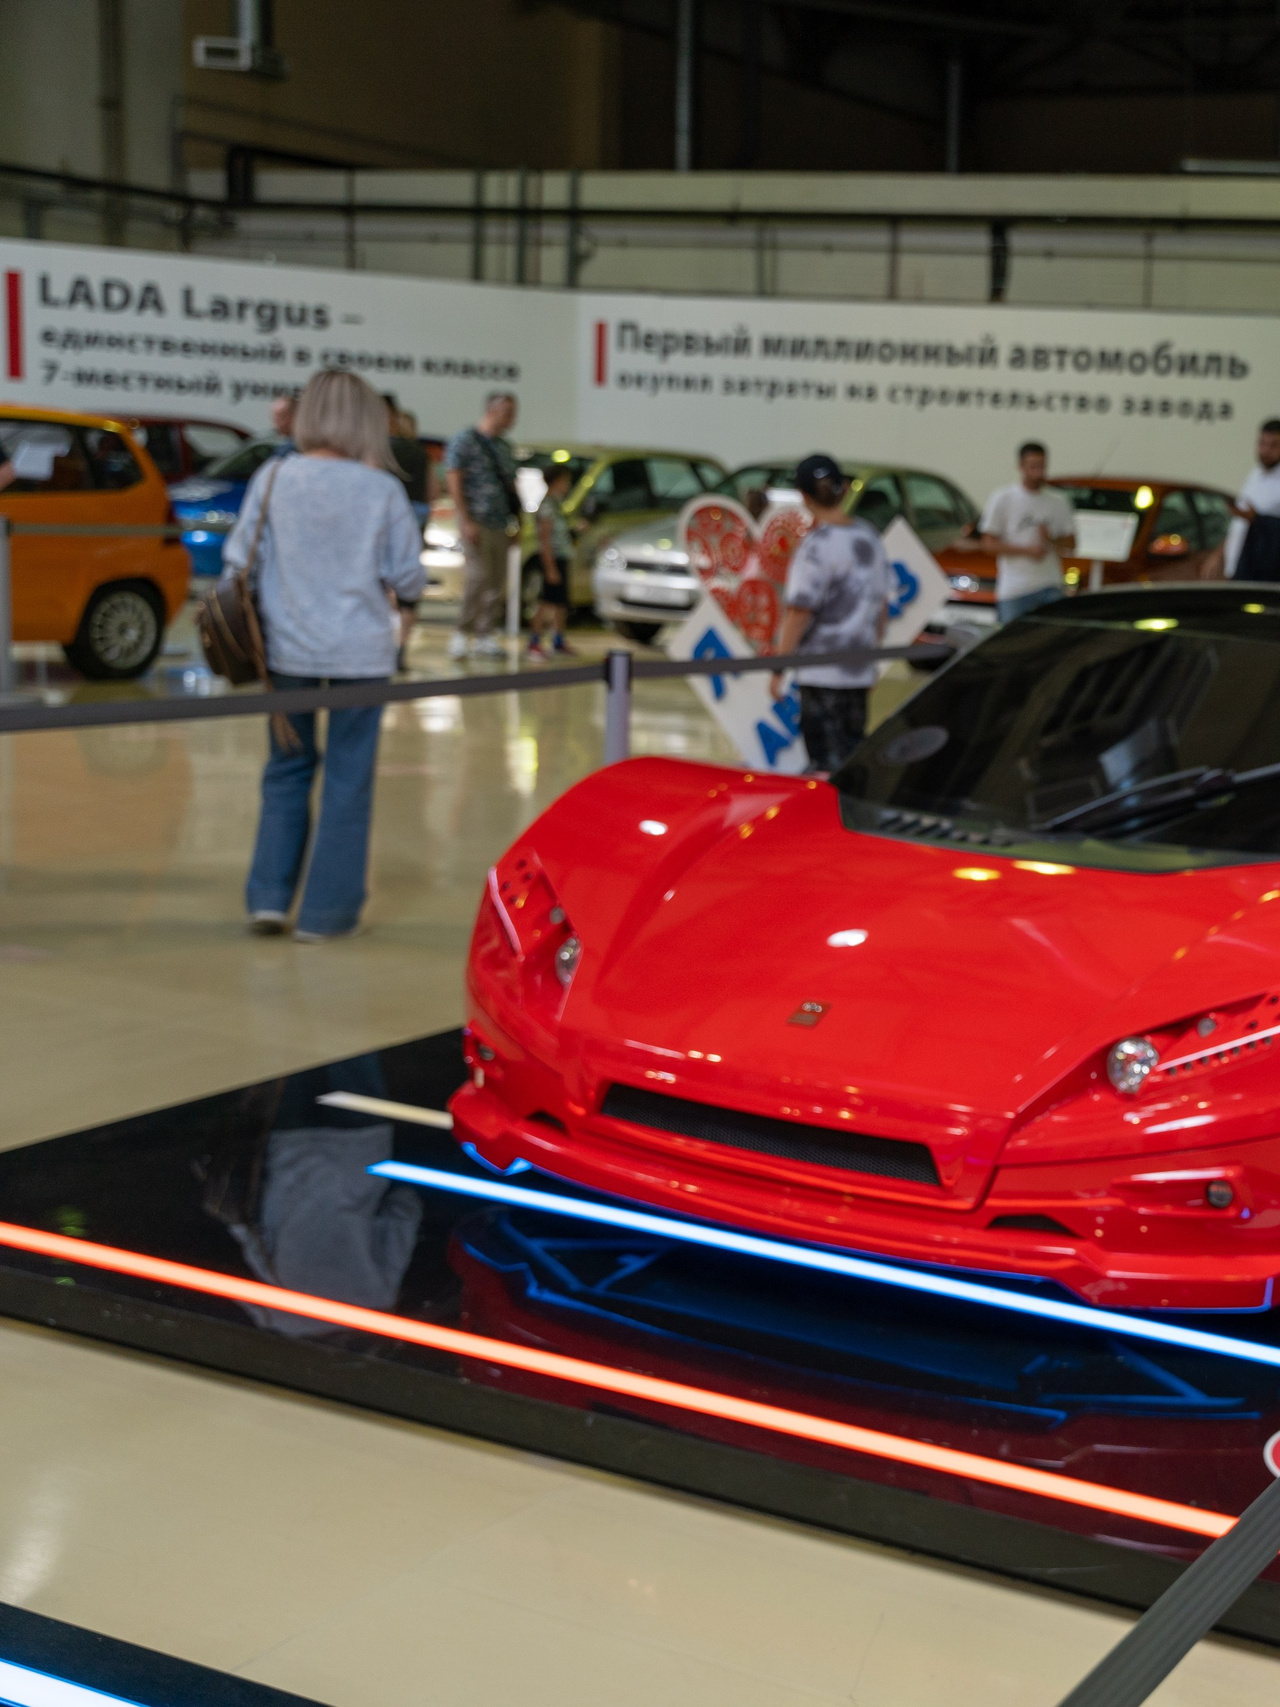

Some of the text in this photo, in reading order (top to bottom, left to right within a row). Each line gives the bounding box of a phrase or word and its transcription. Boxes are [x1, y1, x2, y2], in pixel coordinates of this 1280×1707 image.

[38, 272, 166, 316] LADA
[182, 284, 330, 333] Largus
[40, 325, 286, 364] единственный
[295, 347, 312, 368] в
[422, 358, 520, 382] классе
[41, 357, 223, 397] 7-местный
[616, 319, 1249, 380] Первый миллионный автомобиль
[617, 369, 1234, 426] окупил затраты на строительство завода
